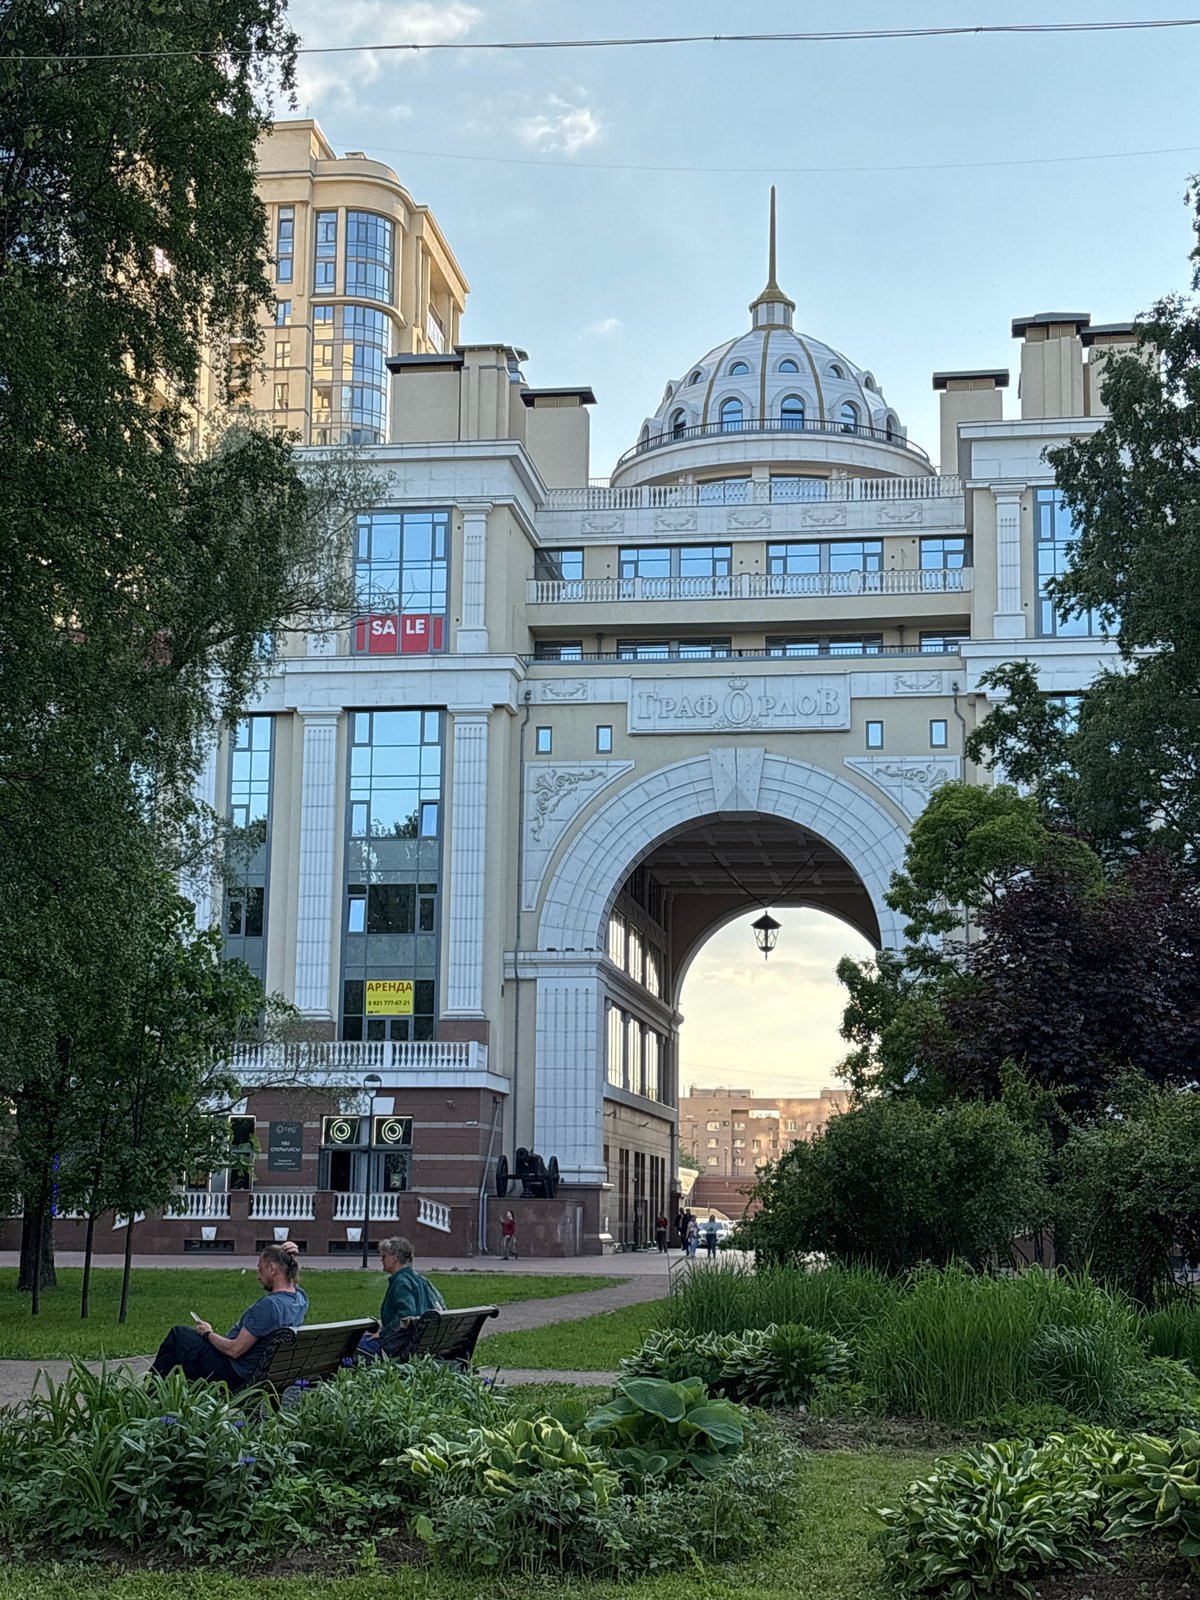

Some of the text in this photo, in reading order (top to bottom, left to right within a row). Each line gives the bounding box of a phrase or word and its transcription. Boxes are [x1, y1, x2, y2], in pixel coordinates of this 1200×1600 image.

[638, 687, 840, 724] ГРАФ ОРЛОВ
[367, 982, 412, 994] АРЕНДА
